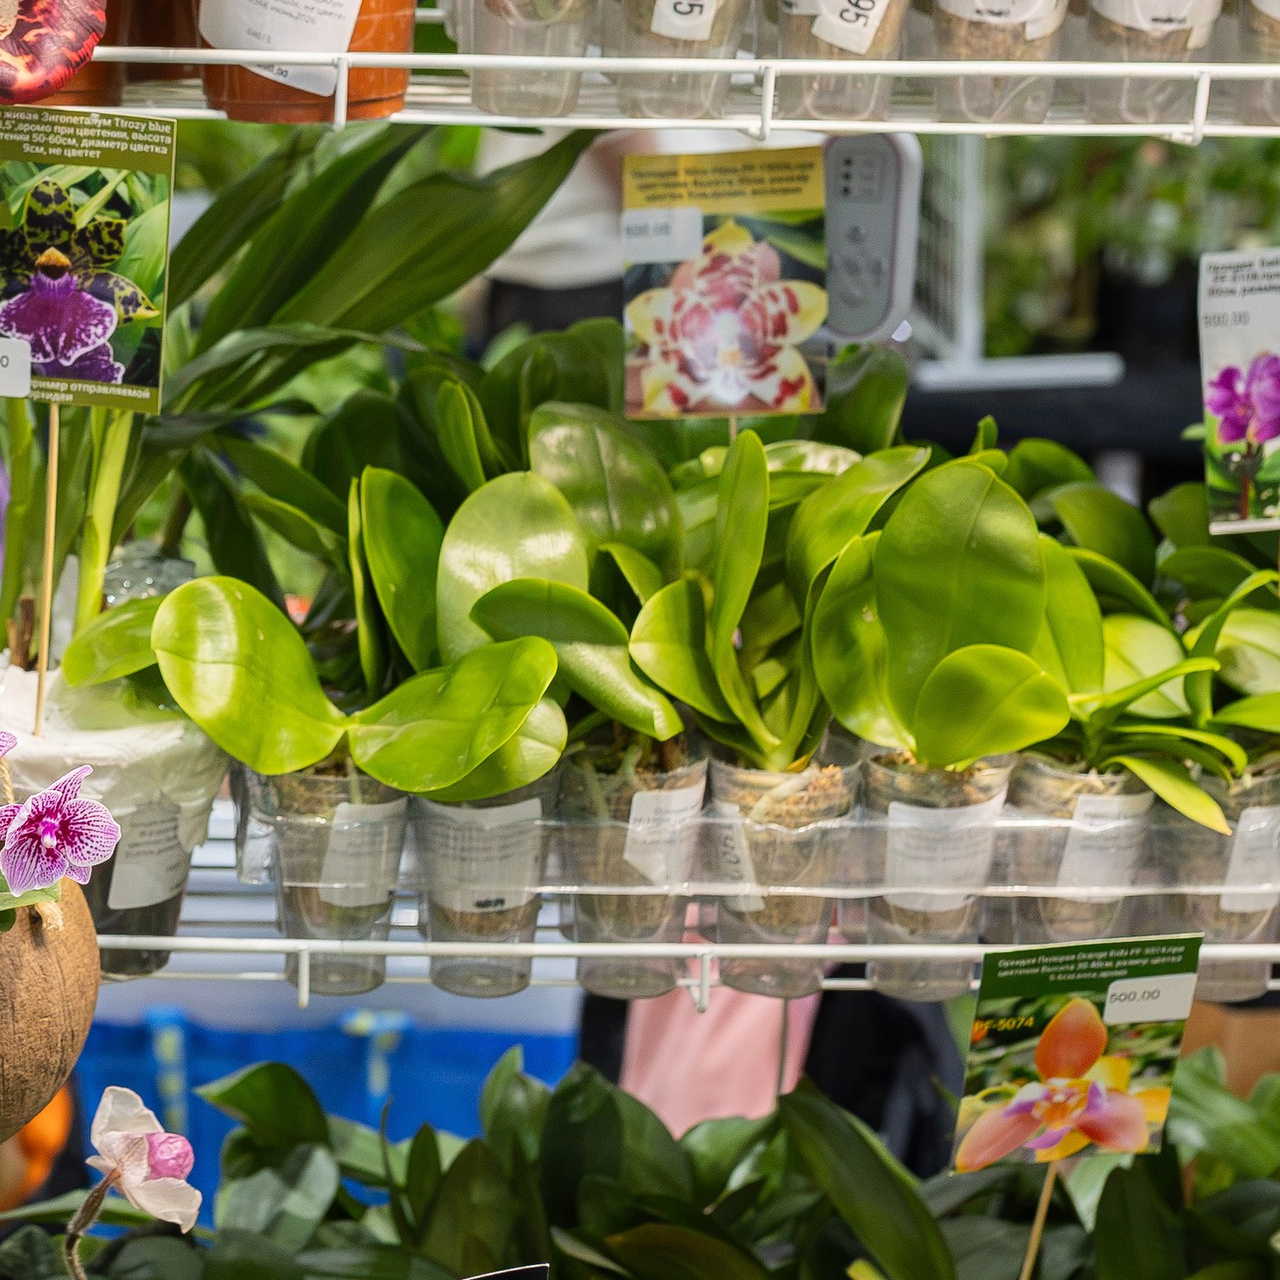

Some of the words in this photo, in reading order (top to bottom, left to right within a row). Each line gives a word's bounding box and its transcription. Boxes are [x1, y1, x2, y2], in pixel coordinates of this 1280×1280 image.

[4, 111, 39, 121] живая
[148, 121, 171, 134] blue
[53, 125, 74, 137] при
[132, 133, 171, 145] высота
[48, 147, 62, 156] не
[64, 149, 101, 159] цветет
[80, 139, 128, 152] диаметр
[130, 143, 167, 155] цветка
[1110, 988, 1161, 1004] 500,00
